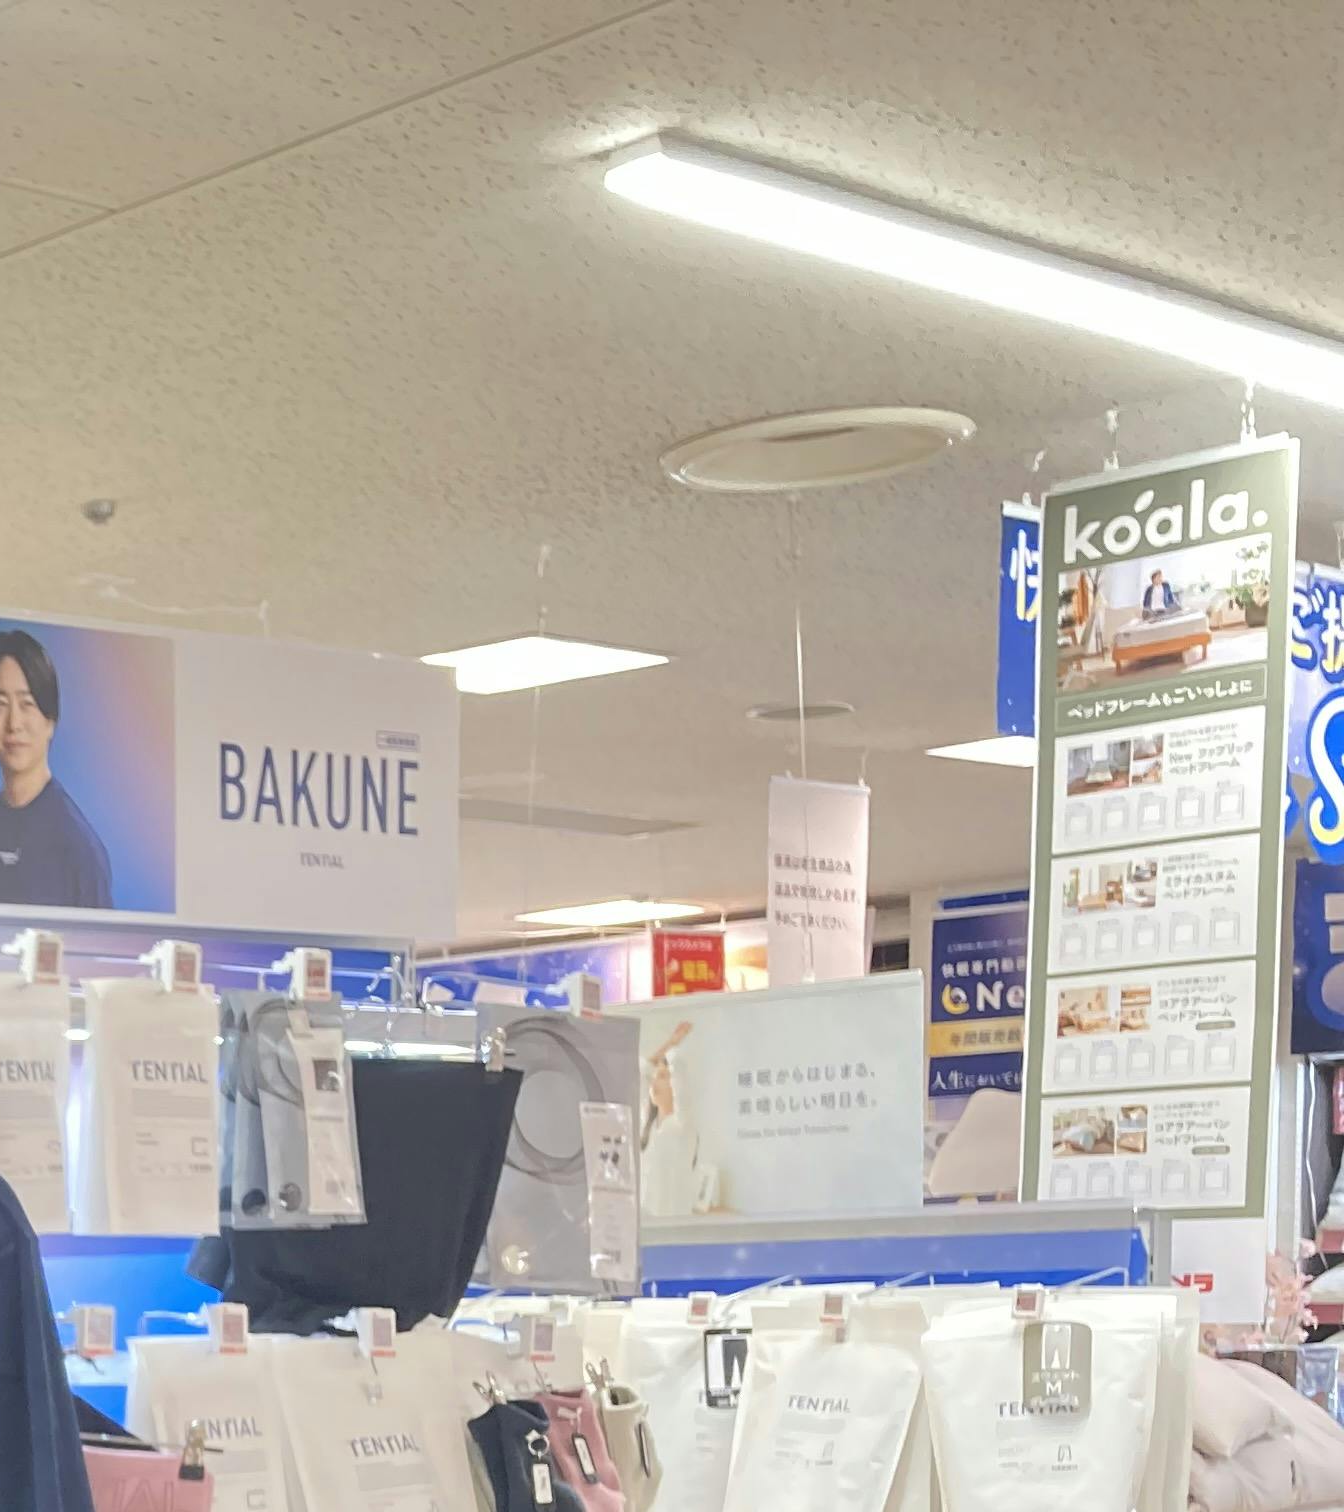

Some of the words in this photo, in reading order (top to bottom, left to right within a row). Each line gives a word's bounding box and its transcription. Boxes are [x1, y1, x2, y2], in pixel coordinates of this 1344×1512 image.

[218, 741, 421, 838] BAKUNE
[131, 1059, 209, 1084] TENTIAL
[1045, 1380, 1063, 1396] M
[787, 1394, 851, 1414] TENTIAL
[203, 1415, 264, 1440] NTIAL
[349, 1433, 422, 1461] TENTIAL
